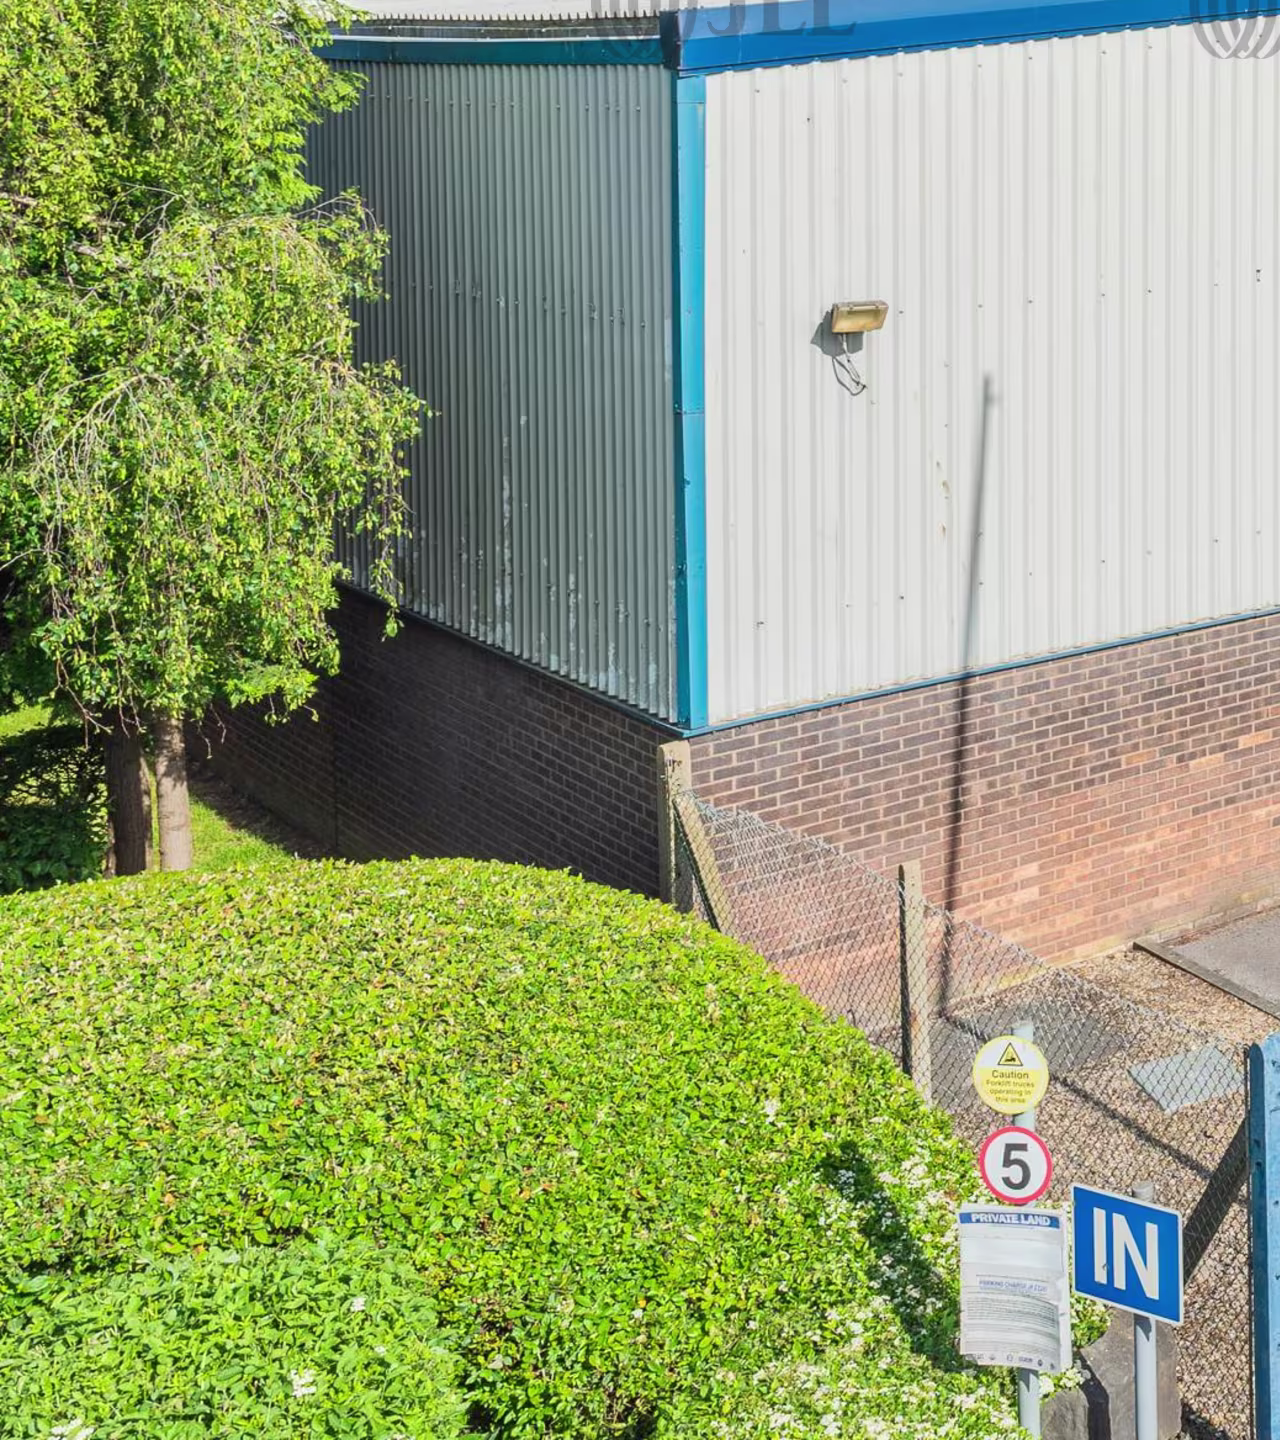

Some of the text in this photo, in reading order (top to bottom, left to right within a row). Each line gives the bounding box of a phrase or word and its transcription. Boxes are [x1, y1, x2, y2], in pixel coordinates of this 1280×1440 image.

[992, 1070, 1029, 1079] Caution
[1001, 1143, 1032, 1191] 5
[971, 1213, 1051, 1226] PRIVATE LAND
[1093, 1207, 1160, 1301] IN
